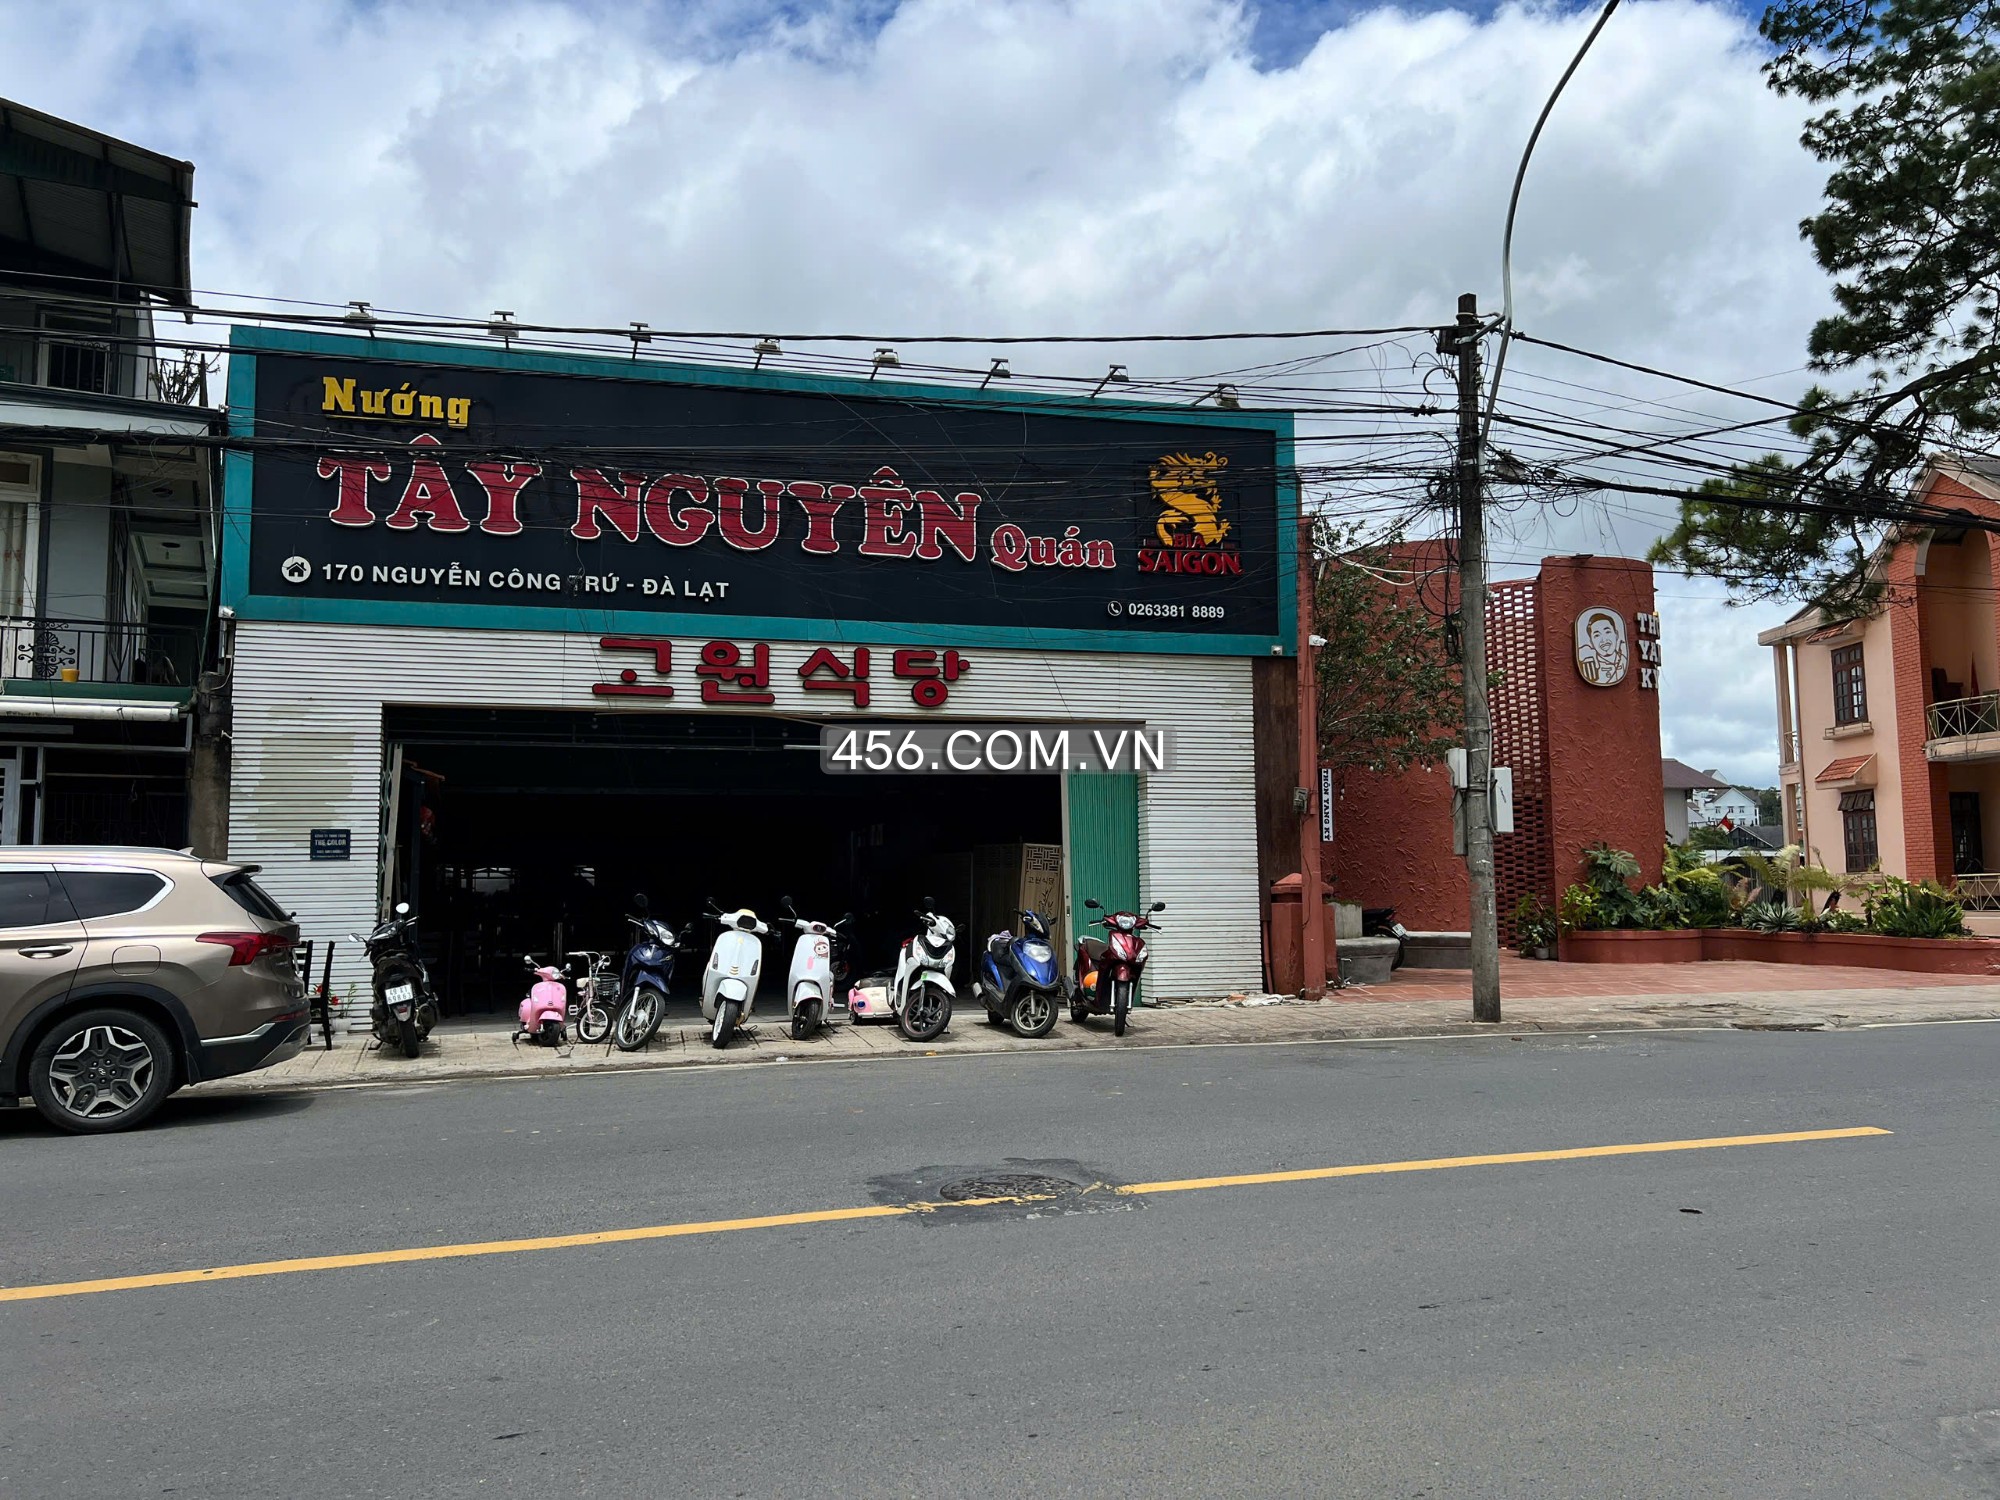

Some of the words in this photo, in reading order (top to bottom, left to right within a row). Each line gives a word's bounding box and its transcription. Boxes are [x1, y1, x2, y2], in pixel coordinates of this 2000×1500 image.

[322, 376, 471, 429] Nướng
[317, 433, 543, 536] TÂY
[569, 466, 982, 563] NGUYÊN
[990, 522, 1116, 573] Quán
[1173, 533, 1206, 549] BIA
[322, 563, 364, 582] 170
[372, 561, 481, 587] NGUYỄN
[488, 567, 561, 591] CÔNG
[642, 575, 676, 596] ĐÀ
[684, 579, 730, 602] LẠT
[1137, 549, 1244, 575] SAIGON
[1128, 602, 1185, 618] 0263381
[1191, 605, 1225, 619] 8889
[591, 636, 970, 707] 고원식당
